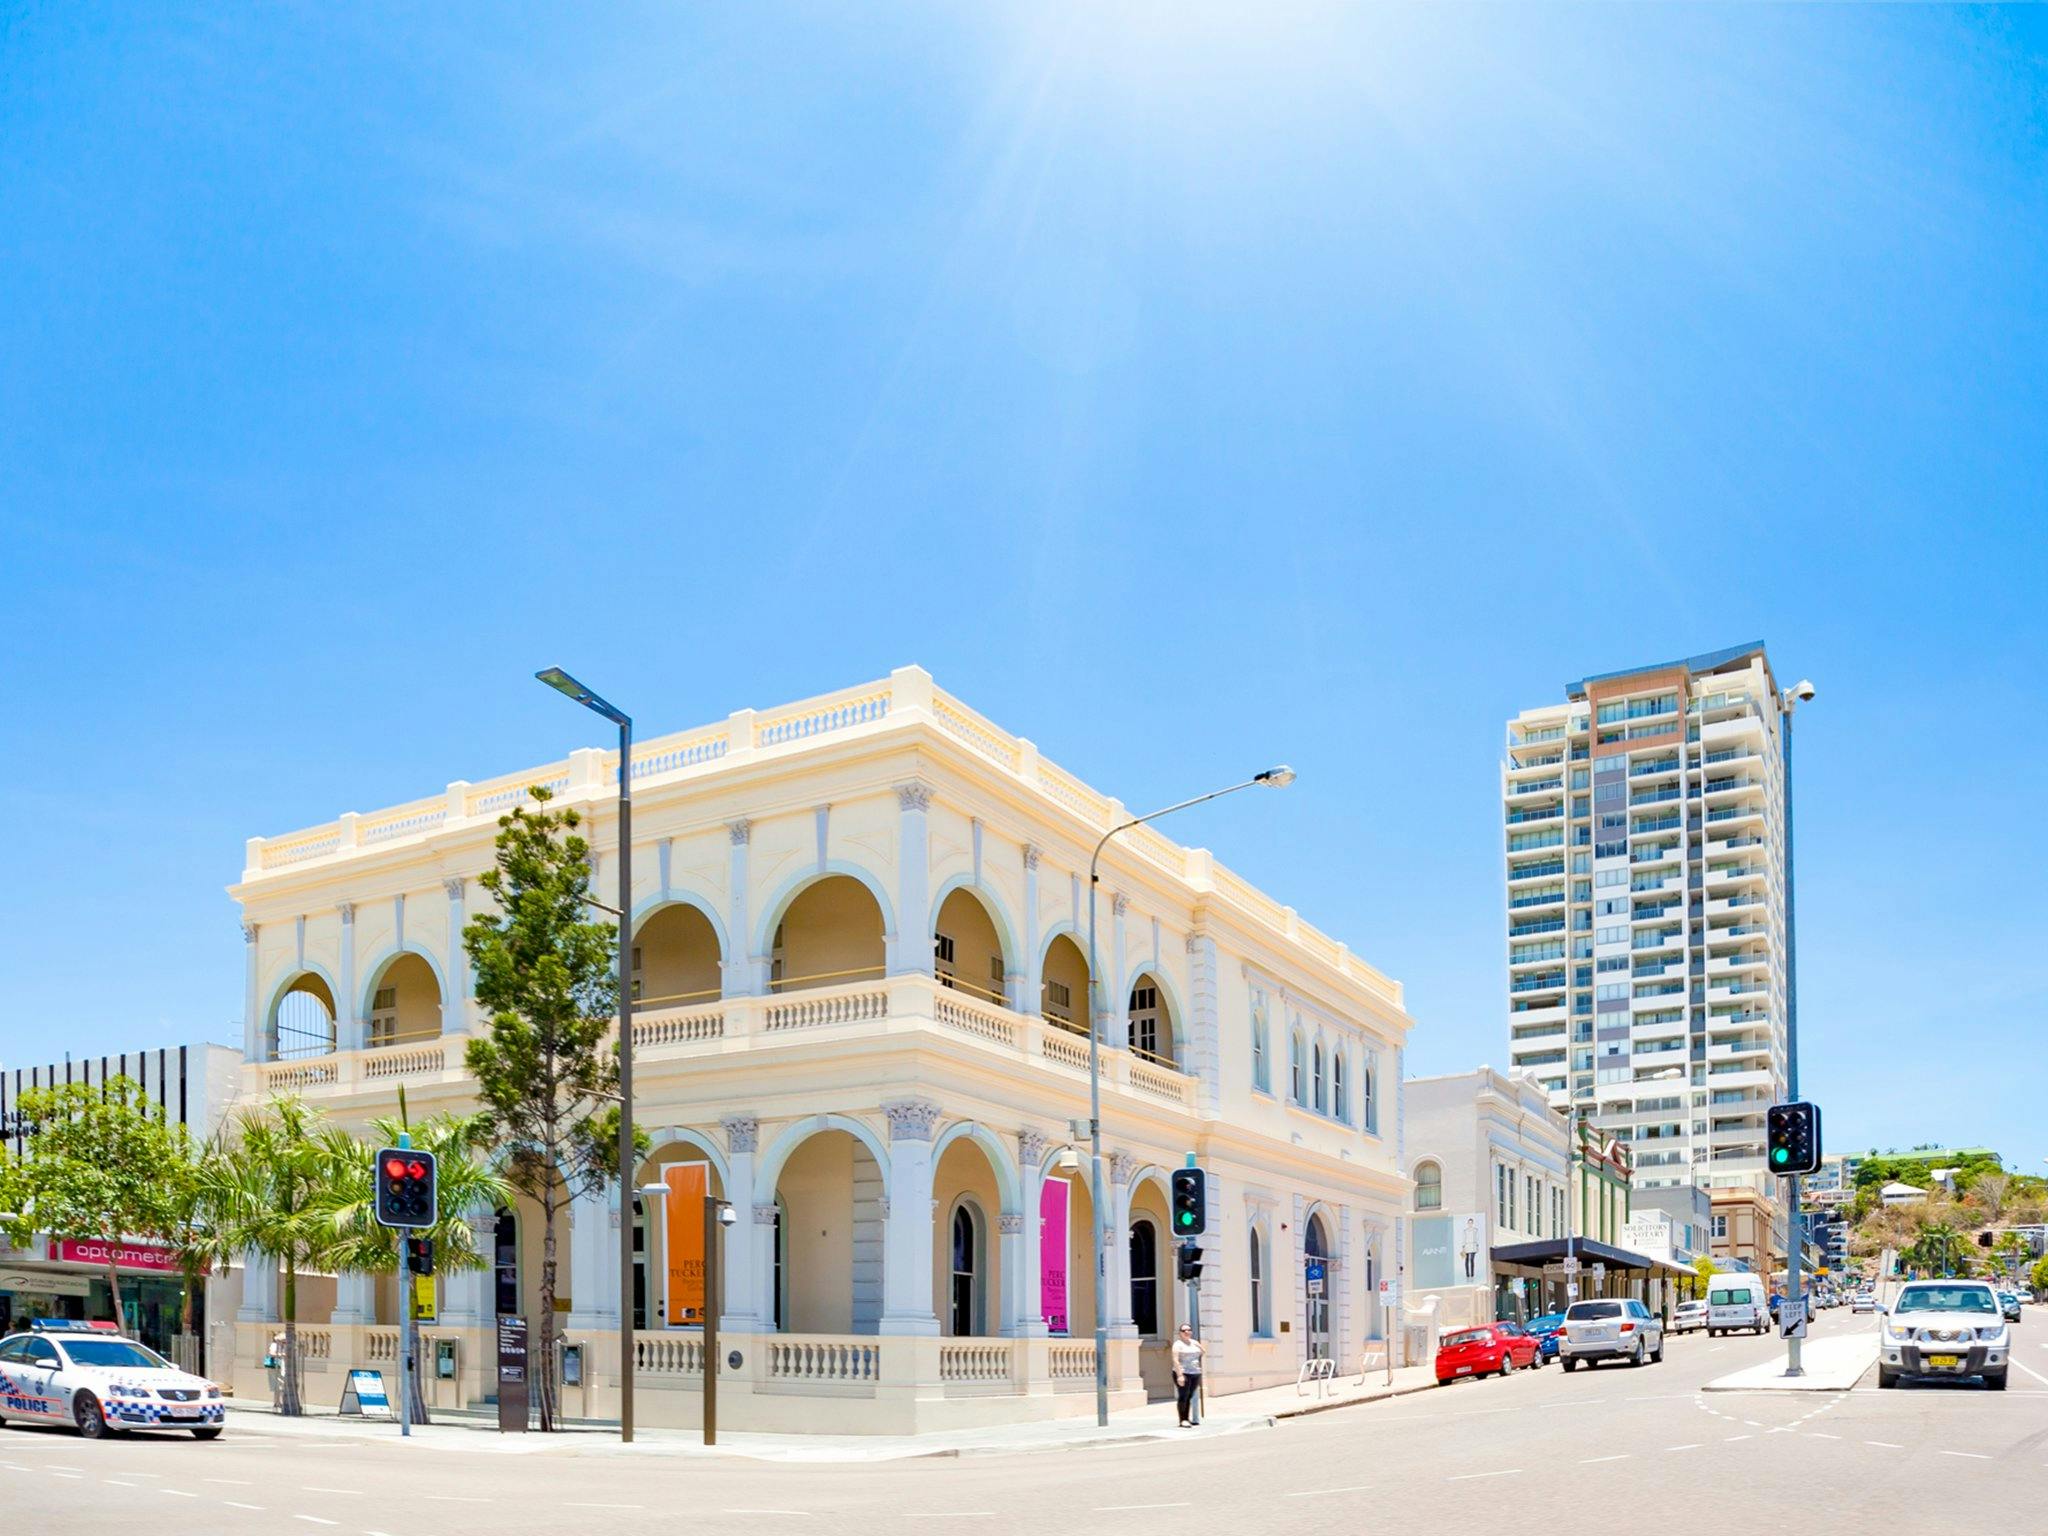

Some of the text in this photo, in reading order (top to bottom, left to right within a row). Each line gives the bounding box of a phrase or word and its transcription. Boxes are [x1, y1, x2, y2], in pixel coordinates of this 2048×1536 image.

[1623, 1224, 1668, 1232] SOLICITORS
[1632, 1230, 1665, 1238] NOTARY
[670, 1268, 706, 1277] TUCKE
[1783, 1303, 1803, 1311] KEEP
[1784, 1310, 1803, 1319] LEFT
[6, 1396, 49, 1414] POLICE
